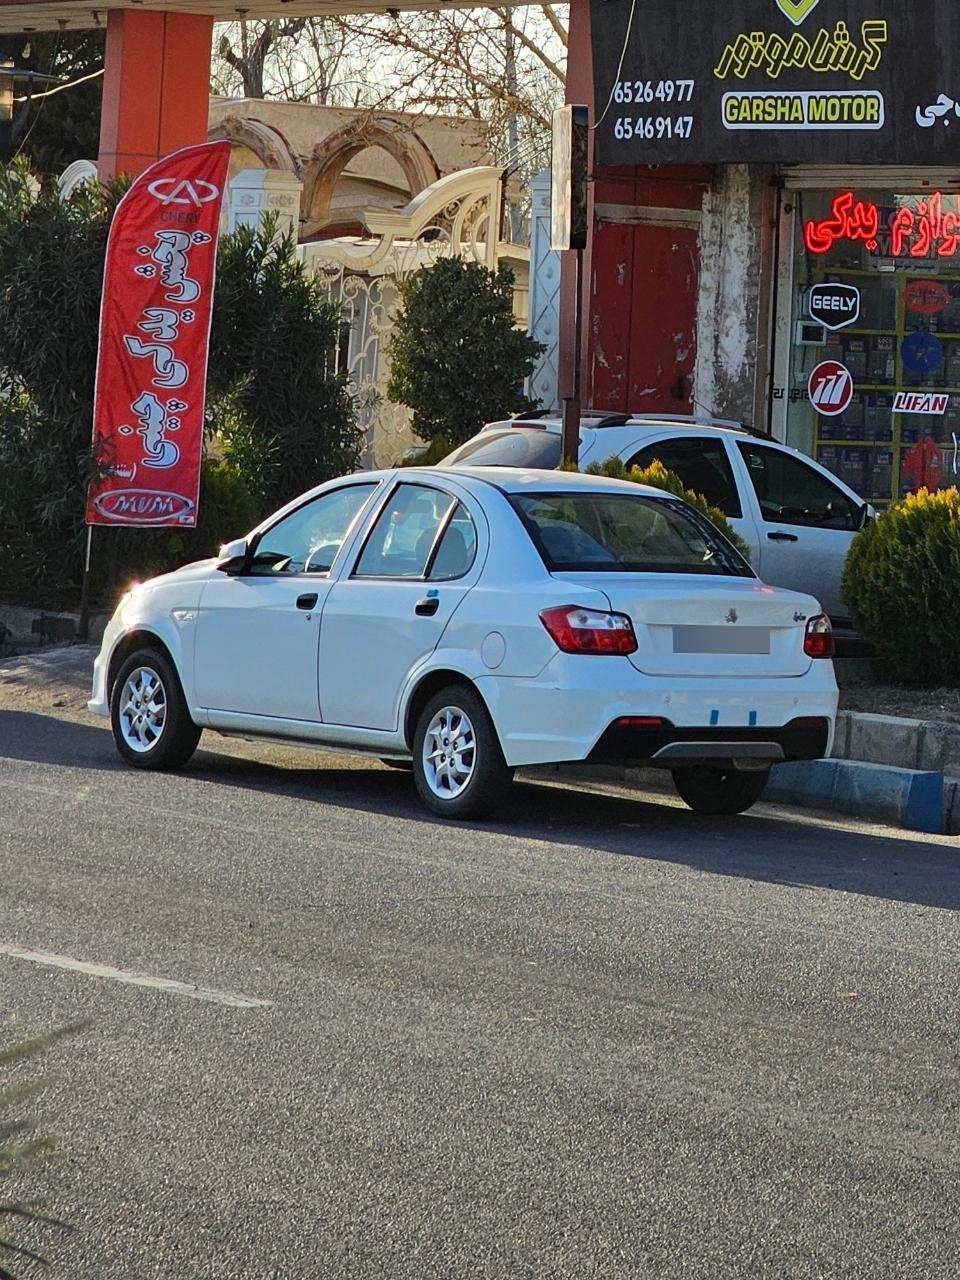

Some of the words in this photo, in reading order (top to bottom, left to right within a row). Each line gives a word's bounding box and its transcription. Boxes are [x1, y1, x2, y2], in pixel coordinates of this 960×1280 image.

[725, 96, 804, 122] GARSHA
[808, 96, 879, 122] MOTOR
[804, 190, 879, 255] یدکی
[134, 228, 212, 305] پخش
[812, 295, 858, 311] GEELY
[123, 305, 196, 389] یدکی
[894, 395, 948, 412] LIFAN
[118, 390, 187, 470] چینی
[110, 495, 174, 513] MVM
